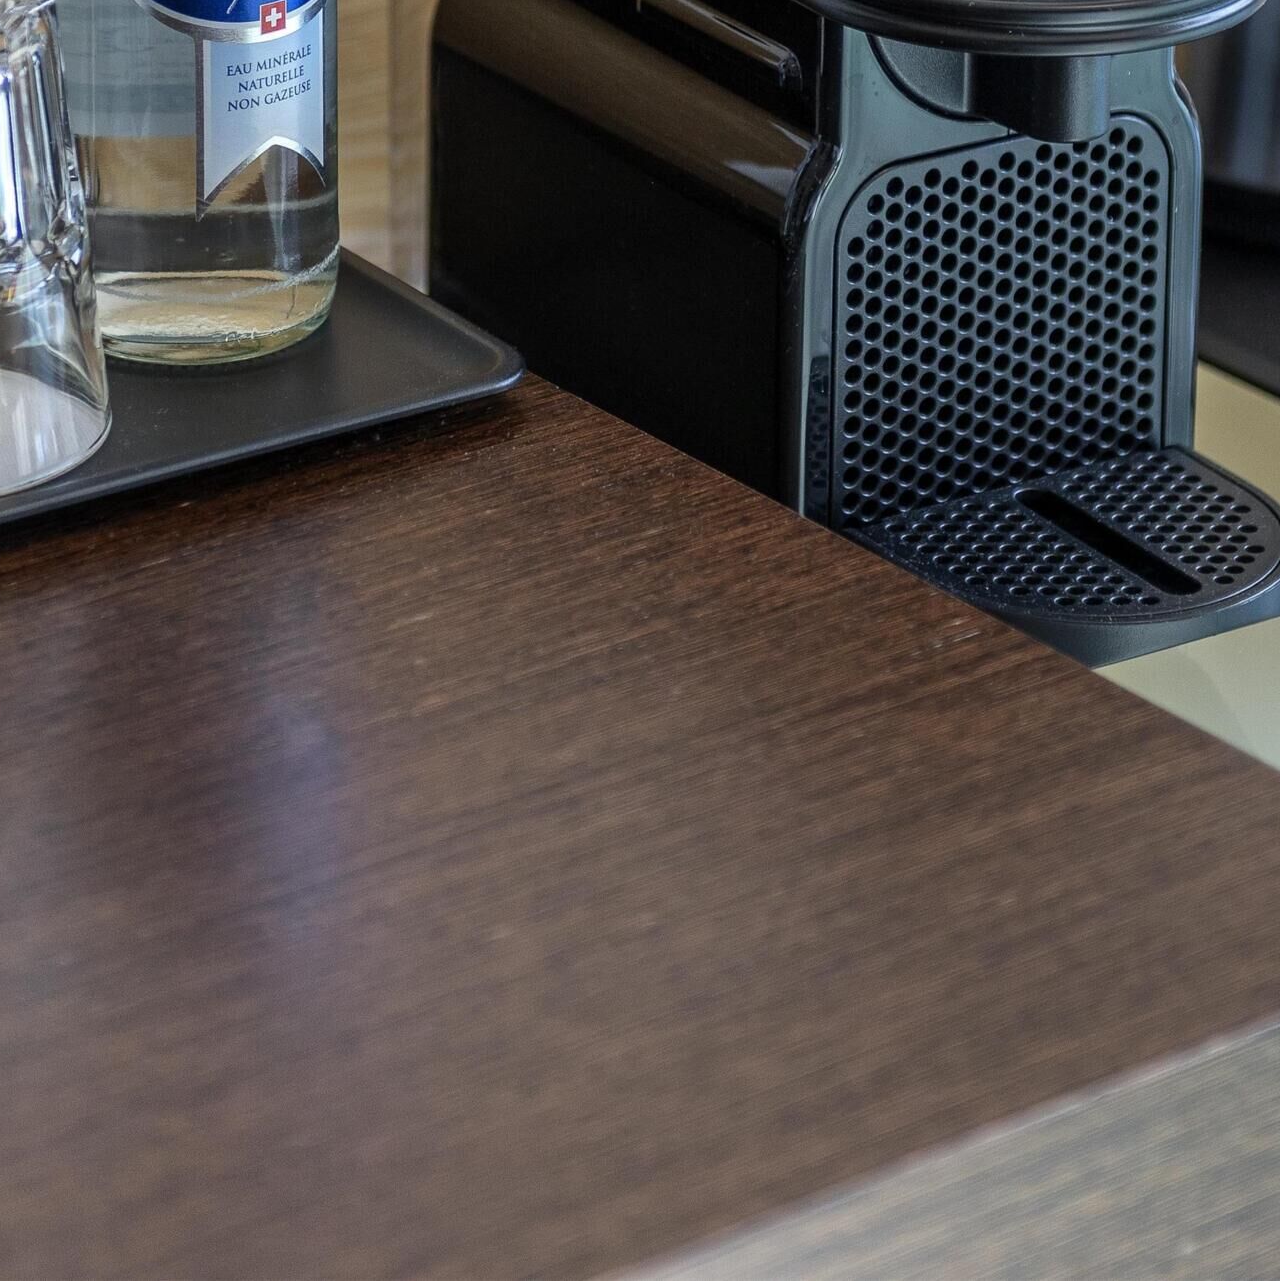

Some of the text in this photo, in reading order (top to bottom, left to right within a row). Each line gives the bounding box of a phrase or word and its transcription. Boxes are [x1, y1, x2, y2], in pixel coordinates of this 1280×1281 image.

[226, 44, 312, 77] EAU MINÉRALE
[238, 64, 305, 93] NATURELLE
[227, 79, 312, 112] NON GAZEUSE
